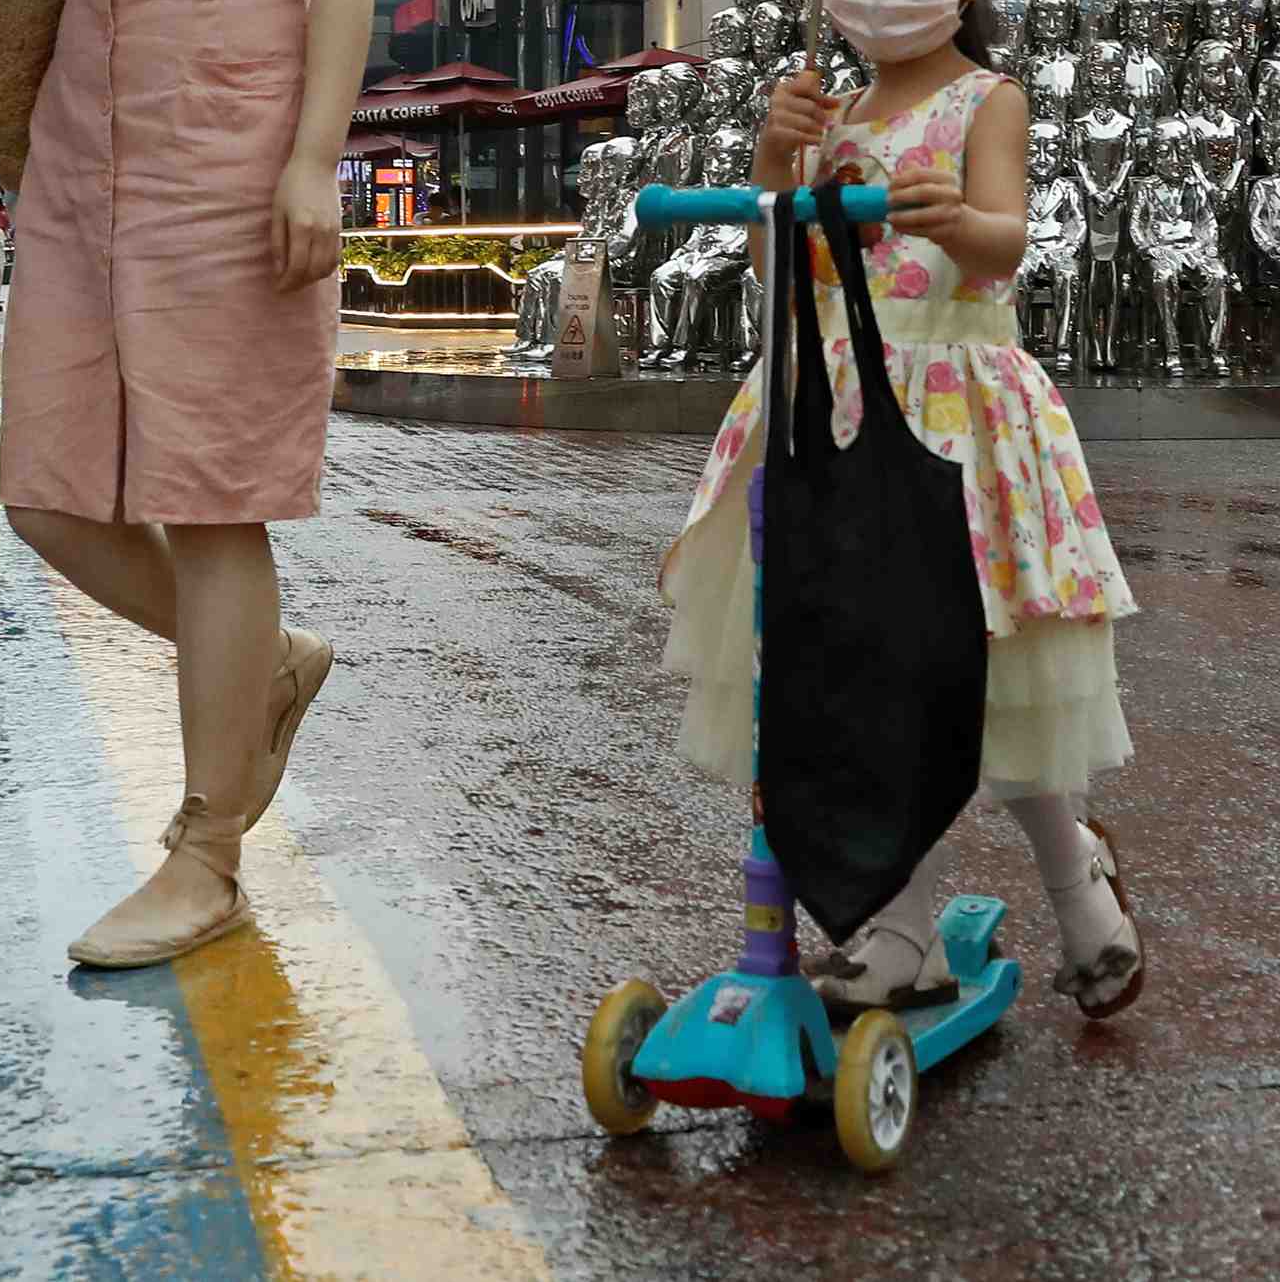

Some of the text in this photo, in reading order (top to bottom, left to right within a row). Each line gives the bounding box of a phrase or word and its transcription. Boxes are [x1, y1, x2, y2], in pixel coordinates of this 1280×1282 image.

[535, 86, 605, 108] COSTA COFFEE
[391, 104, 441, 120] COFFEE
